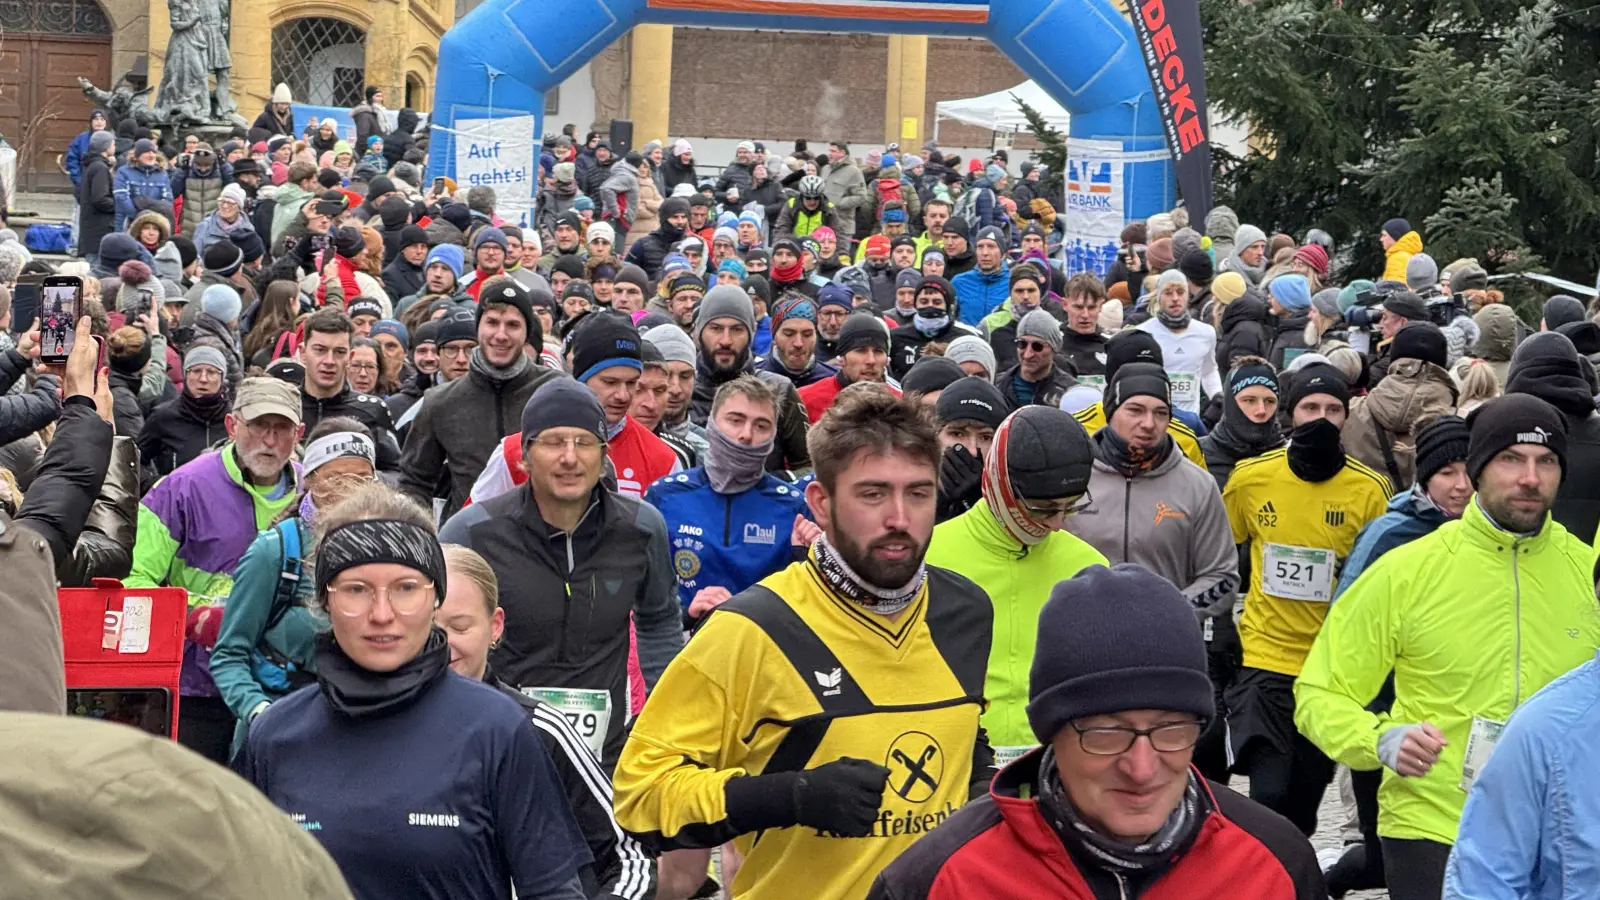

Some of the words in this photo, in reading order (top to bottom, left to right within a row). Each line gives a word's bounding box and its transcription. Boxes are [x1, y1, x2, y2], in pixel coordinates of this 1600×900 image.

[468, 141, 501, 159] Auf
[1079, 194, 1112, 208] BANK
[1516, 431, 1544, 444] PUMA
[1257, 513, 1278, 528] PS2
[678, 524, 703, 537] JAKO
[743, 522, 776, 545] Maul
[1275, 561, 1314, 582] 521
[408, 812, 460, 828] SIEMENS
